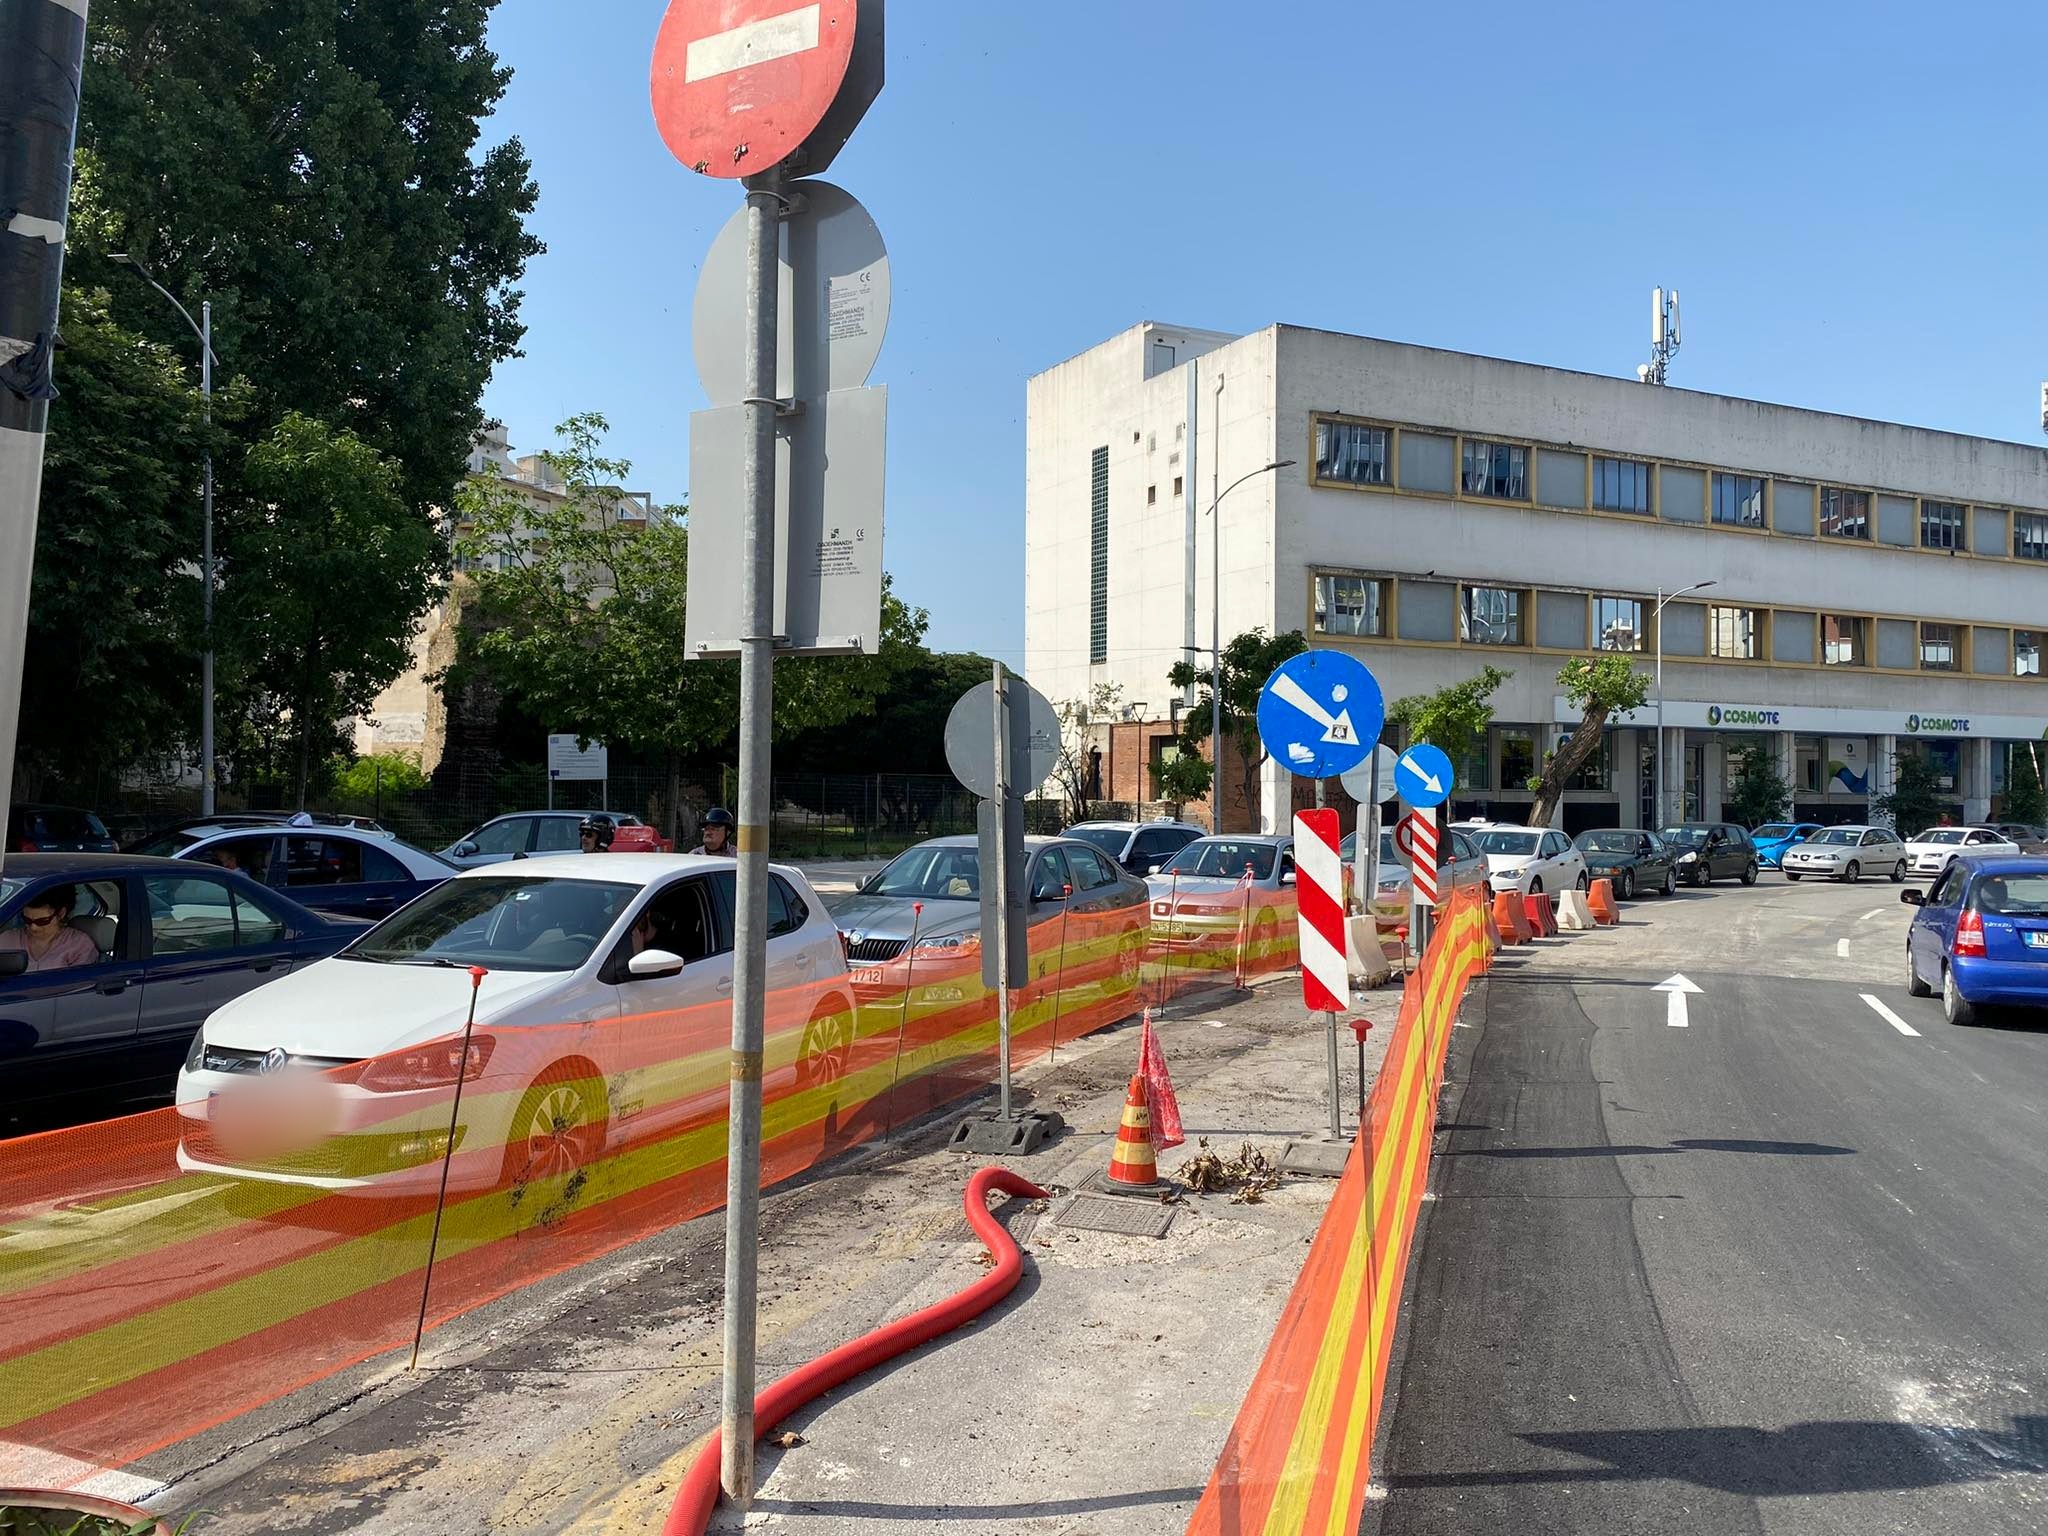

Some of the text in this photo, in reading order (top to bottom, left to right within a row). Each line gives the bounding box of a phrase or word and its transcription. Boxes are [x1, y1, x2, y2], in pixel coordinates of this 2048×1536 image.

[1723, 709, 1780, 725] COSMOTE
[1921, 717, 1970, 732] COSMOTE
[853, 969, 880, 983] 1712
